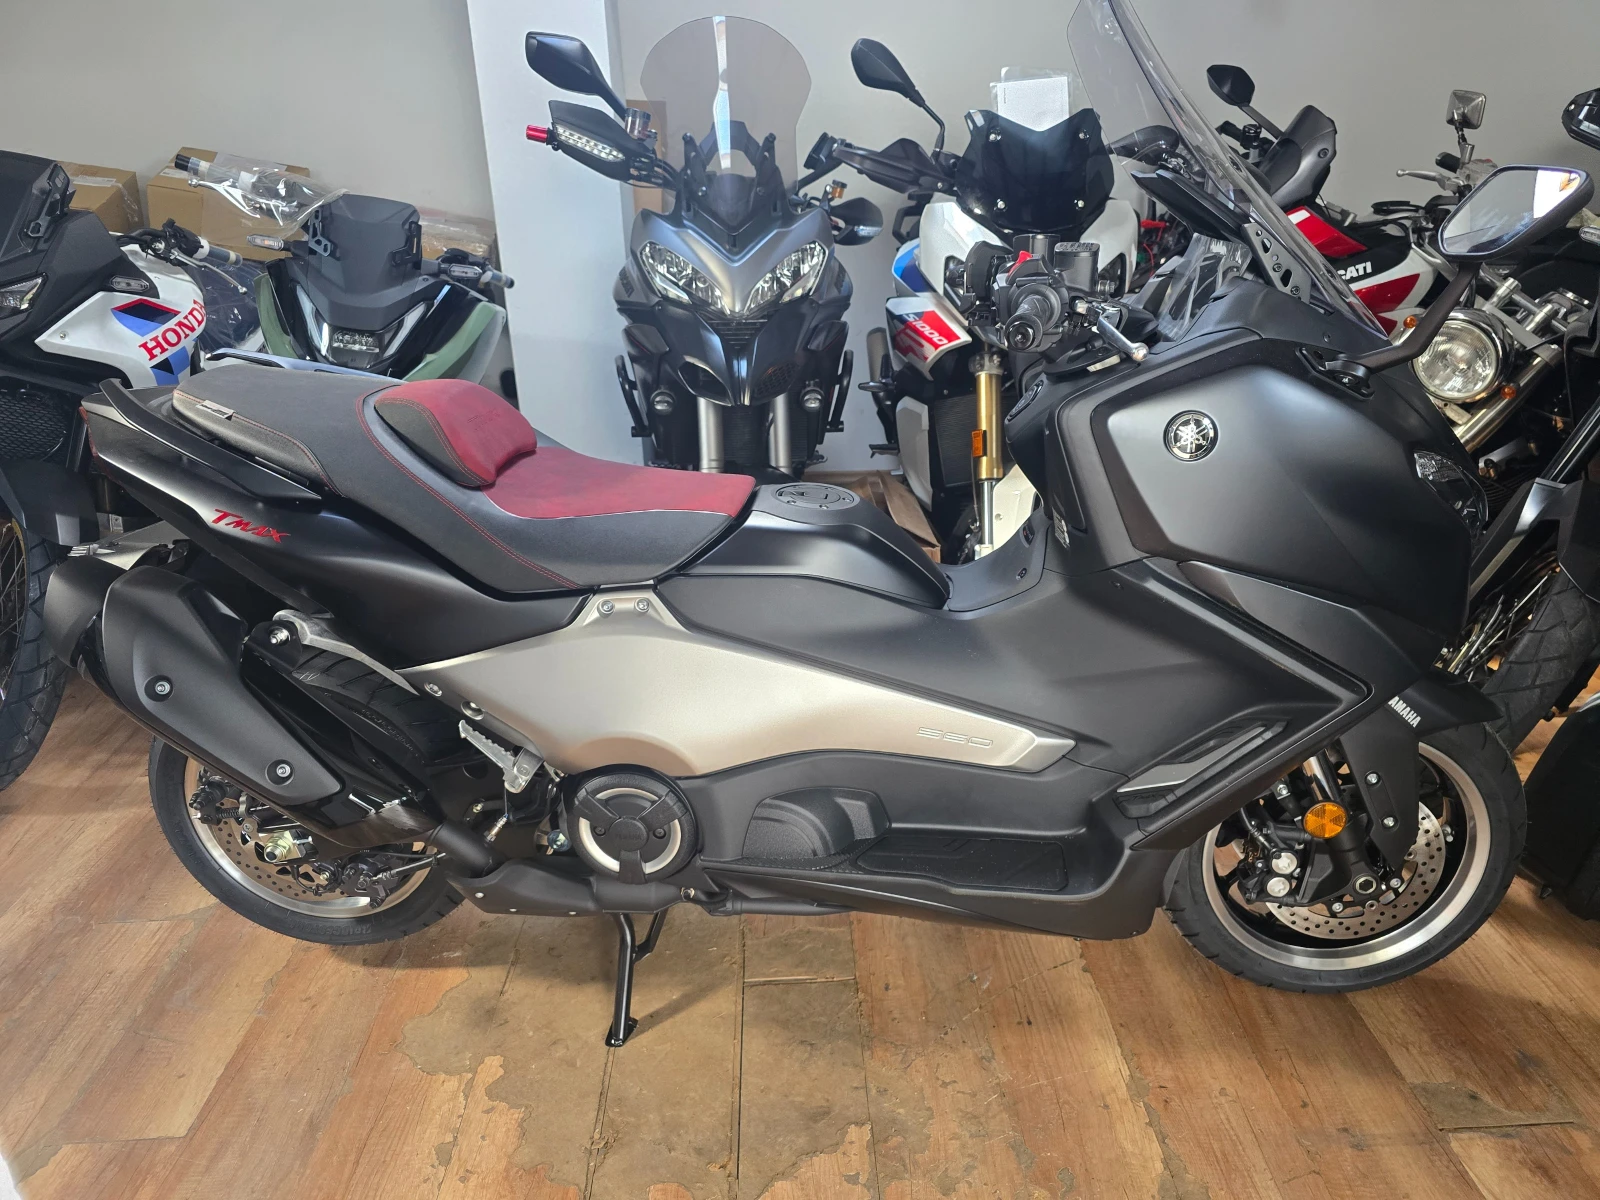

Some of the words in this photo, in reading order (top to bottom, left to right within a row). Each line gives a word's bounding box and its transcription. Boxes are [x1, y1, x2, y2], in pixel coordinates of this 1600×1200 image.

[1337, 261, 1372, 280] CATI
[138, 299, 206, 361] HONDA
[903, 313, 949, 345] S1000
[211, 508, 291, 543] TMAX
[1387, 695, 1421, 728] AMAHA
[916, 726, 993, 748] 560
